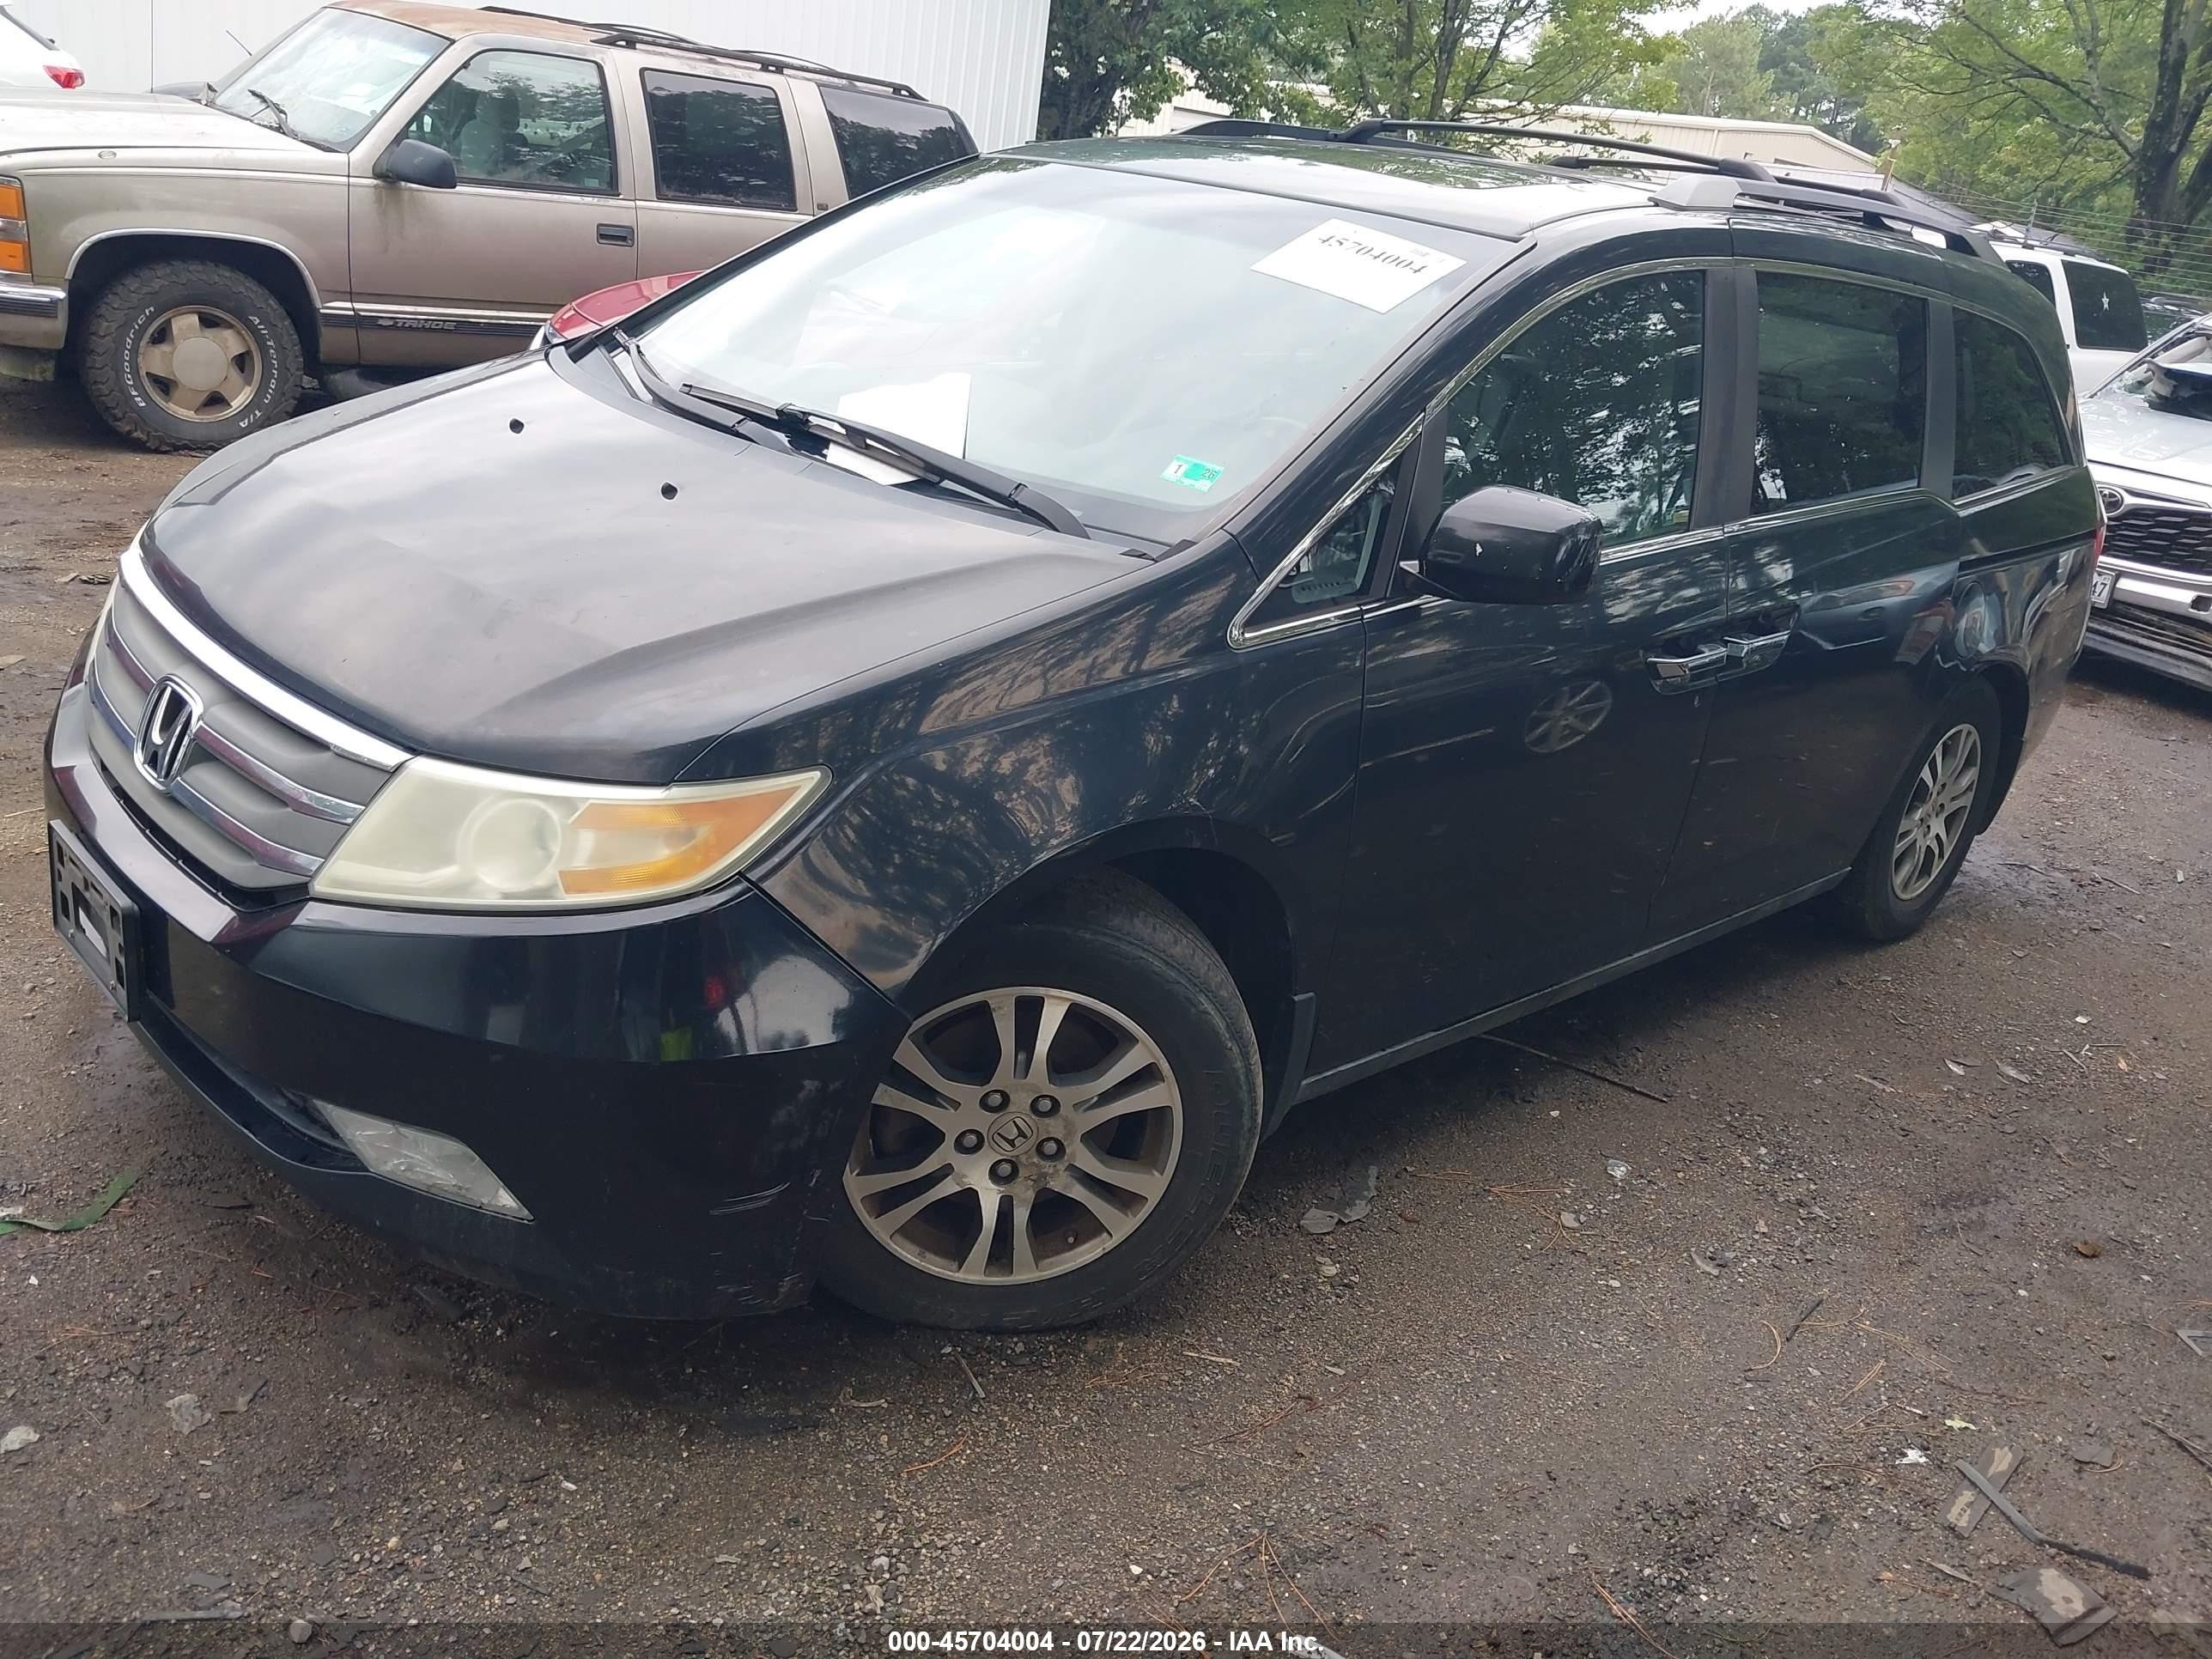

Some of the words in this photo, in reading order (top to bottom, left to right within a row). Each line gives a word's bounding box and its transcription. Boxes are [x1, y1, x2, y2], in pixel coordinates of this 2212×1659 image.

[1318, 234, 1427, 274] 45704004
[395, 318, 457, 331] TAHOE
[123, 305, 155, 408] BFGoodrich
[247, 314, 278, 404] All-Terrain
[239, 410, 263, 428] T/A
